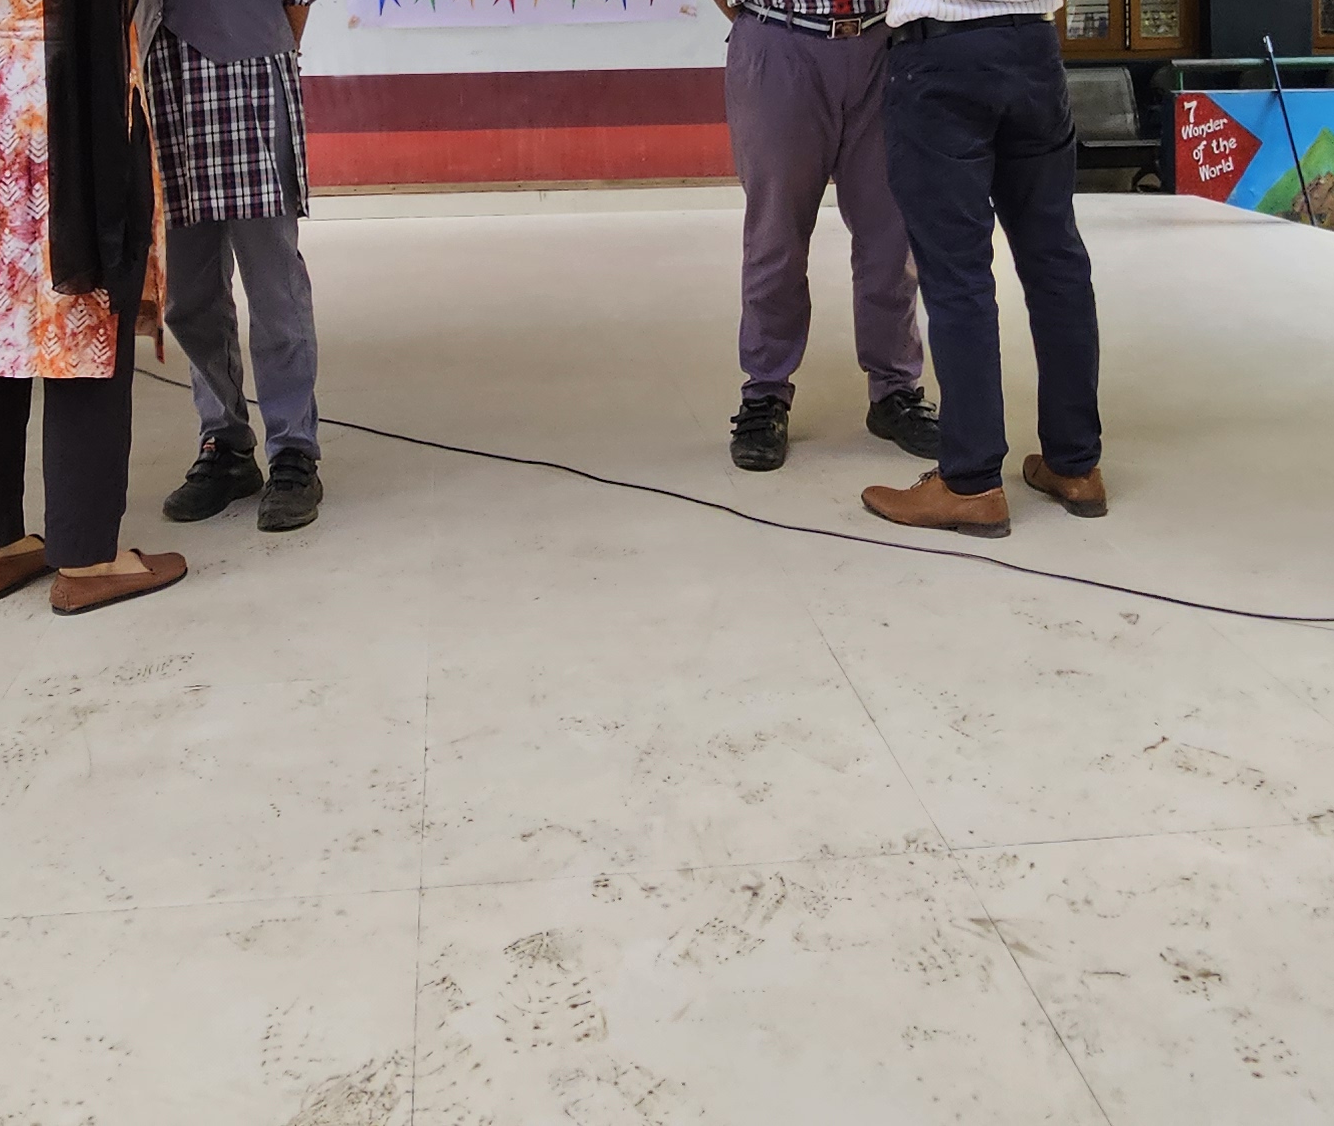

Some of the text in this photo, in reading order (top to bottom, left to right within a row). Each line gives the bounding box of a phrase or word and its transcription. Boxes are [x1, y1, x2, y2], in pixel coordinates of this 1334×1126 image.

[1183, 100, 1198, 123] 7
[1181, 118, 1228, 140] Wonder
[1193, 137, 1238, 165] of the
[1198, 156, 1234, 182] World
